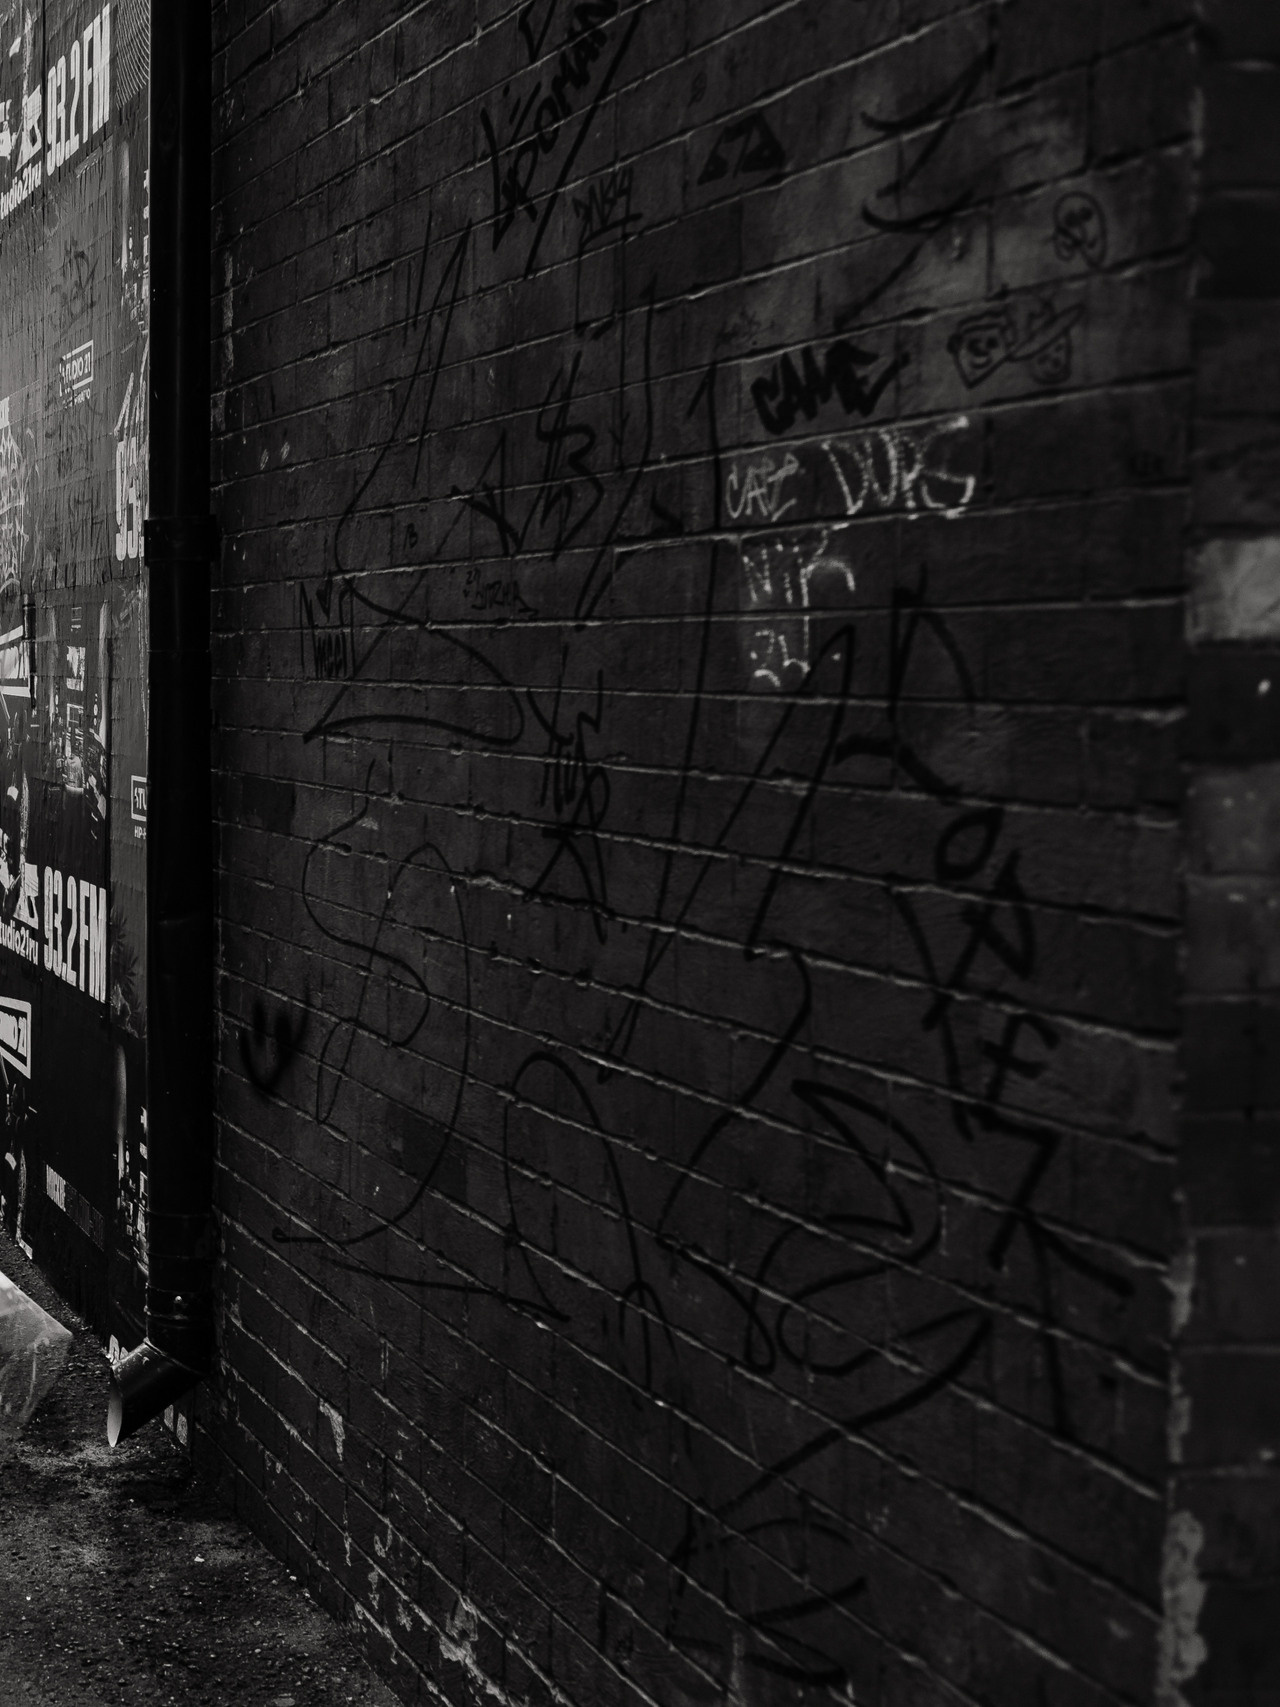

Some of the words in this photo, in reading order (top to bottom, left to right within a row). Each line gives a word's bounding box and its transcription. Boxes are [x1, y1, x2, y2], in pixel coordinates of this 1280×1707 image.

[46, 40, 80, 176] 93.2
[83, 3, 111, 143] FM
[44, 865, 77, 988] 93.2
[79, 879, 107, 1003] FM
